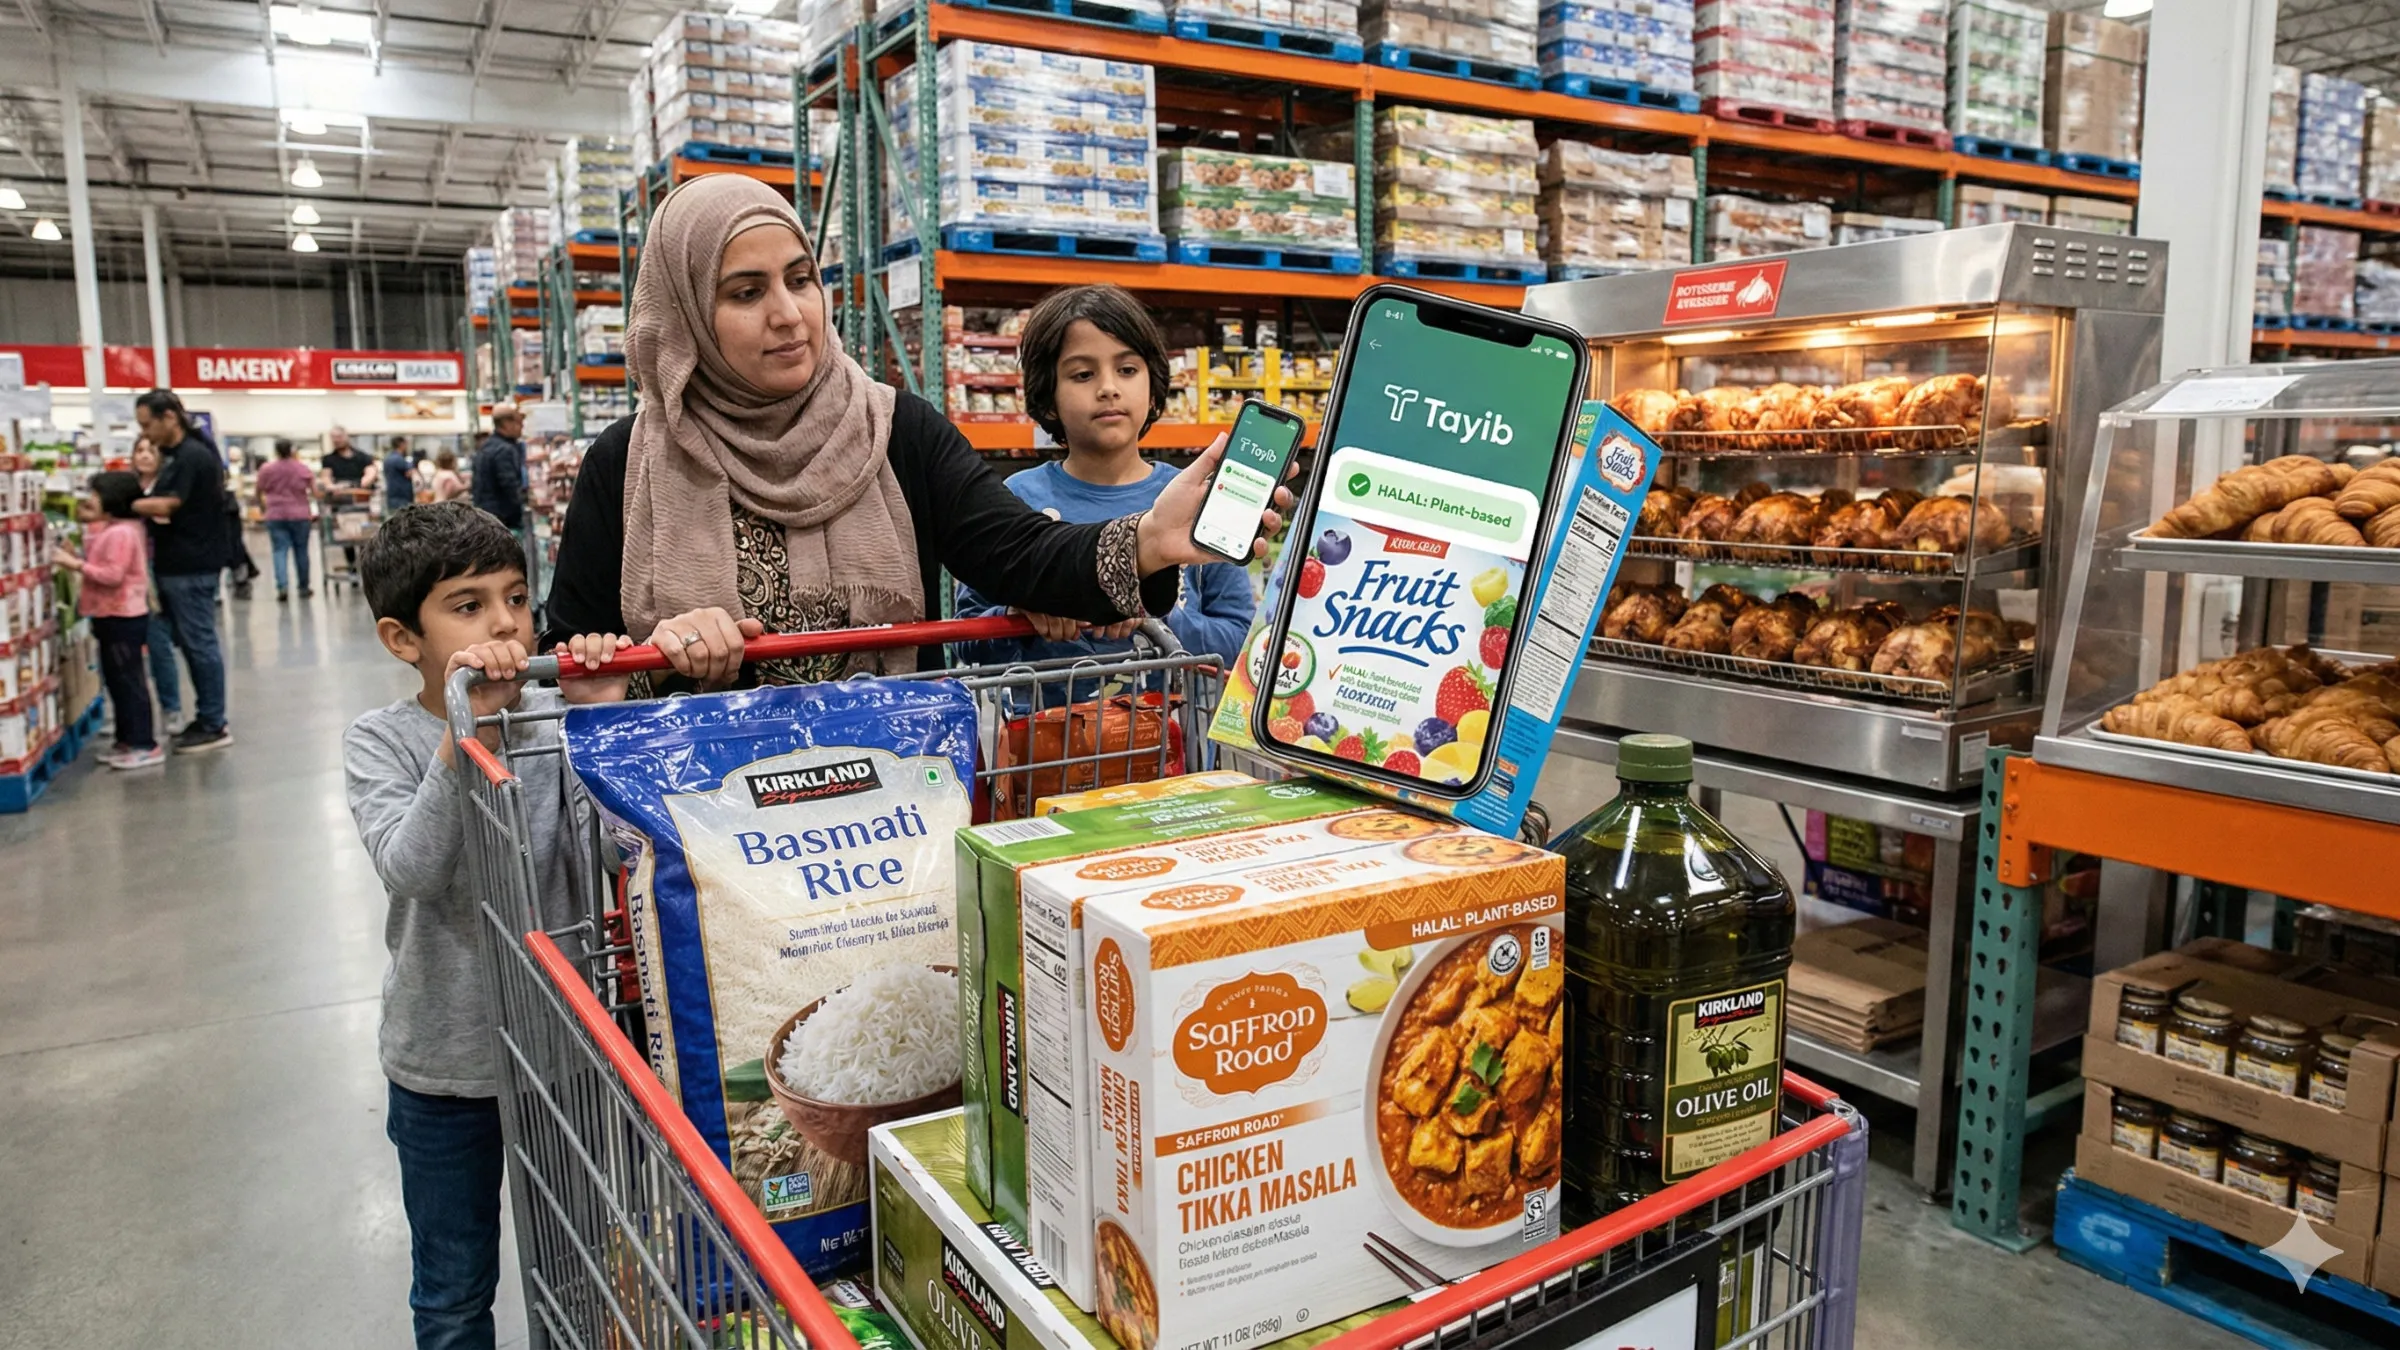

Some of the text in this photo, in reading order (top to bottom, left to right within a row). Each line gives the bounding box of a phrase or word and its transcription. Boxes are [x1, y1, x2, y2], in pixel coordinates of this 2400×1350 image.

[196, 357, 295, 383] BAKERY
[1423, 396, 1514, 446] Tayib
[1378, 483, 1512, 528] HALAL: Plant-based
[1349, 559, 1461, 609] Fruit
[1312, 590, 1466, 656] Snacks
[753, 761, 872, 794] KIRKLAND
[761, 780, 877, 806] Signature
[732, 803, 928, 866] Basmati
[796, 856, 906, 901] Rice
[1465, 894, 1558, 927] PLANT-BASED
[631, 893, 660, 1017] Basmati
[1697, 991, 1765, 1018] KIRKLAND
[1004, 991, 1018, 1110] KIRKLAND
[1100, 1062, 1114, 1132] MASALA
[1675, 1087, 1738, 1119] OLIVE
[1742, 1077, 1773, 1103] OIL
[1112, 1071, 1130, 1216] CHICKEN TIKKA
[1175, 1125, 1241, 1150] SAFFRON
[1176, 1138, 1285, 1196] CHICKEN
[1176, 1186, 1253, 1235] TIKKA
[1259, 1156, 1358, 1214] MASALA
[944, 1245, 1006, 1330] KIRKLAND
[1222, 1332, 1234, 1347] 11
